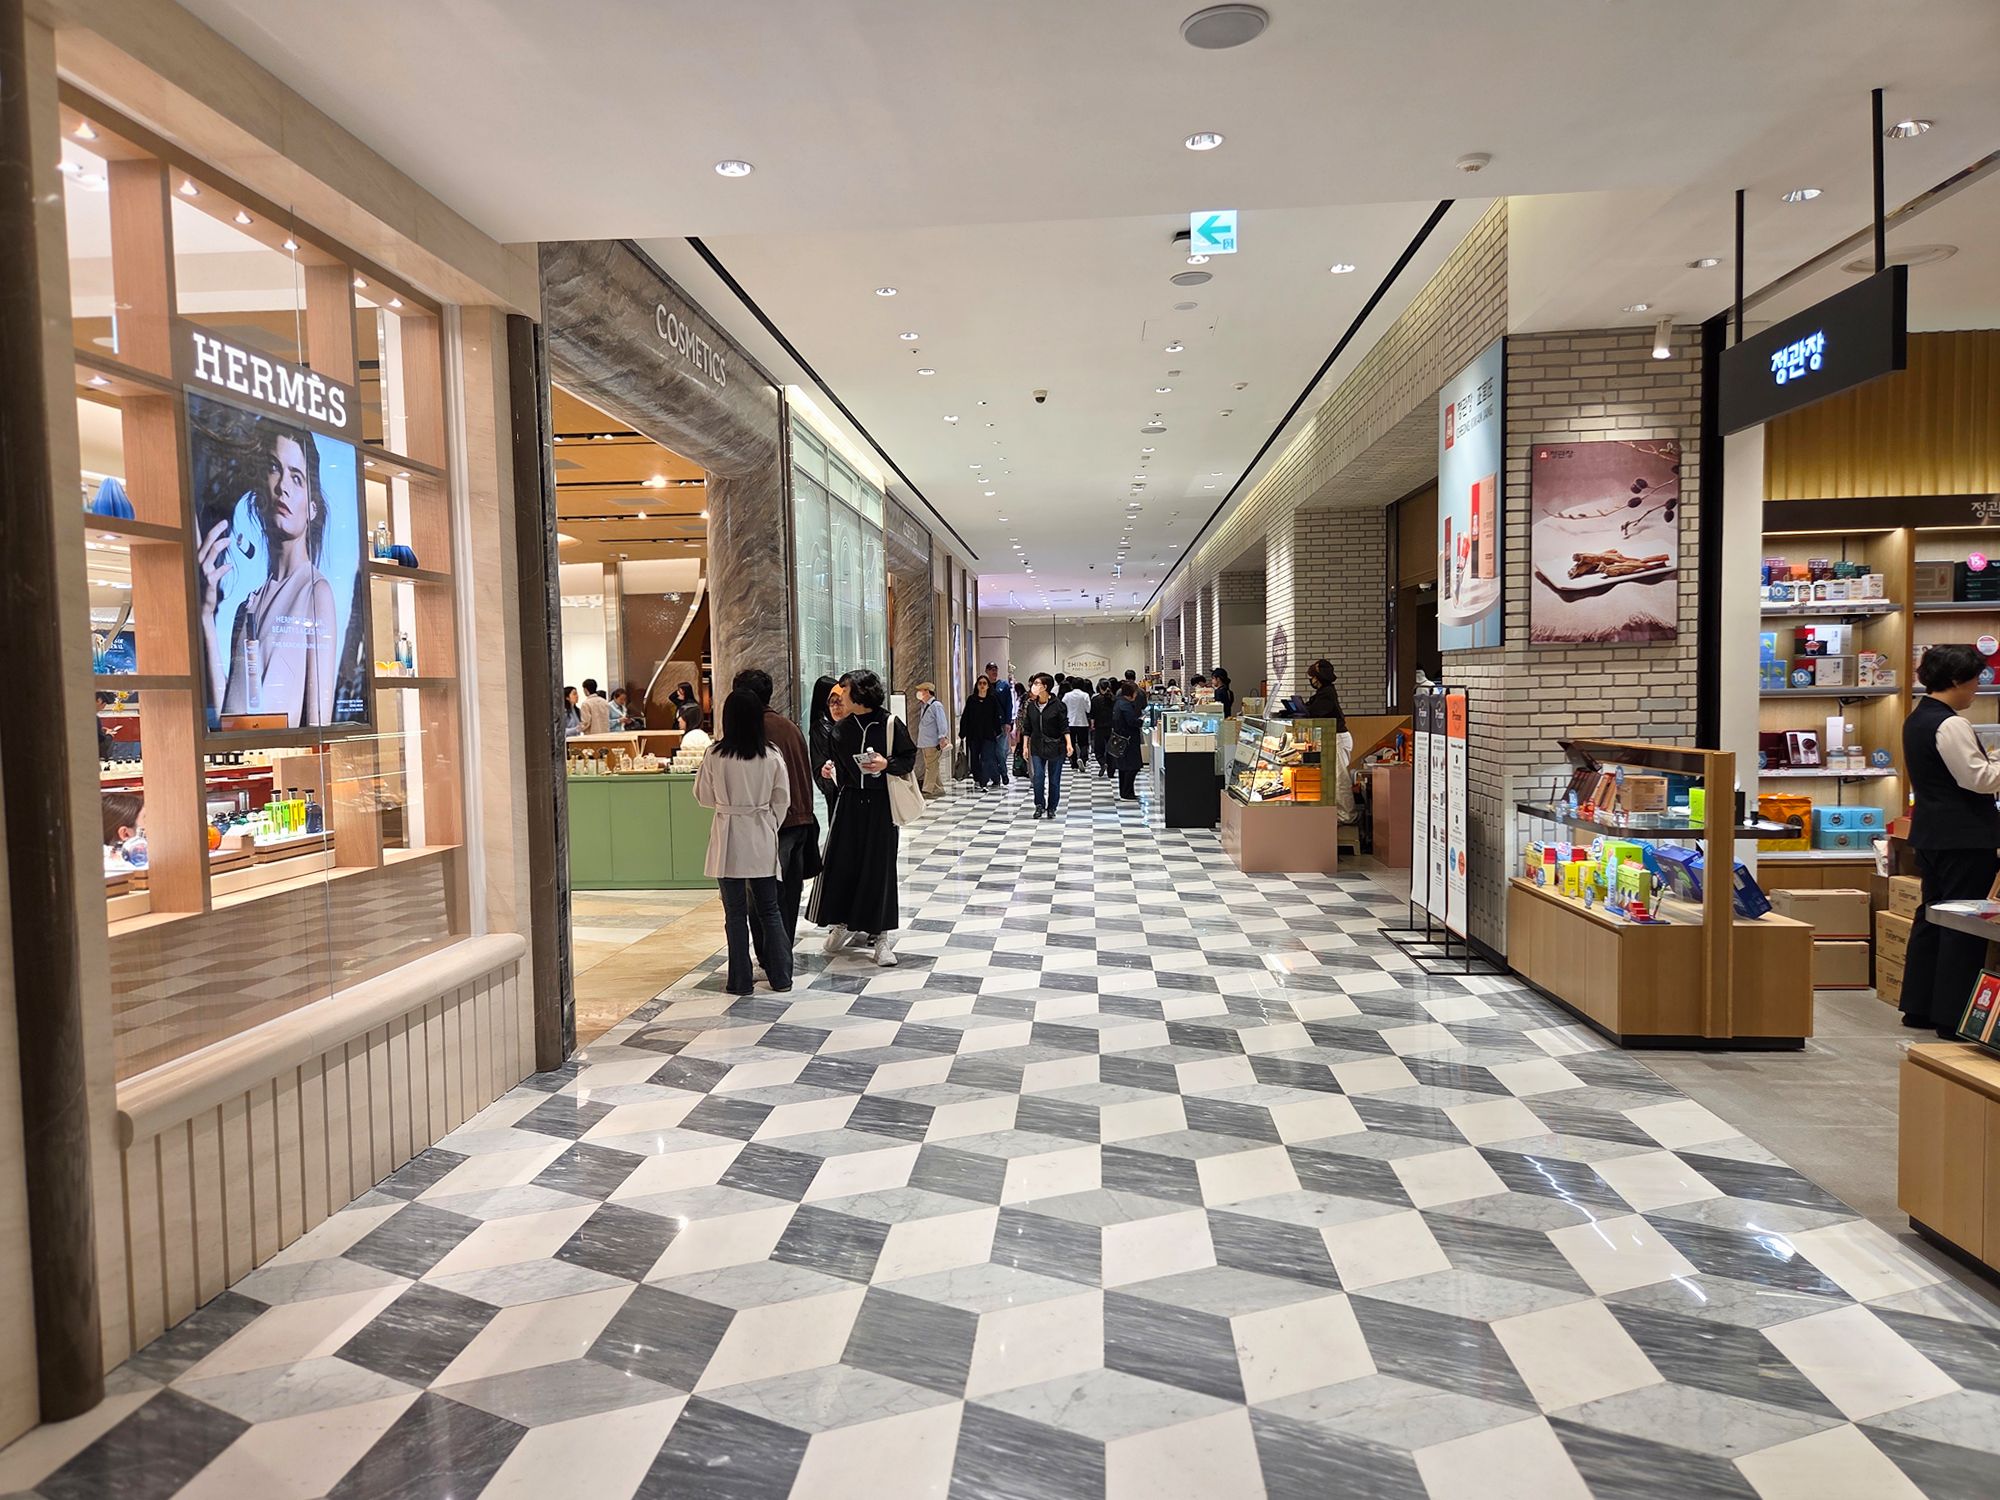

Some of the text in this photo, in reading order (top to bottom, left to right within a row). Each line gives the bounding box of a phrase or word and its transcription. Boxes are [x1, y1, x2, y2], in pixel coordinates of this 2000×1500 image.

[192, 332, 347, 428] HERMÈS
[656, 303, 726, 387] COSMETICS
[1771, 330, 1825, 385] 정관장
